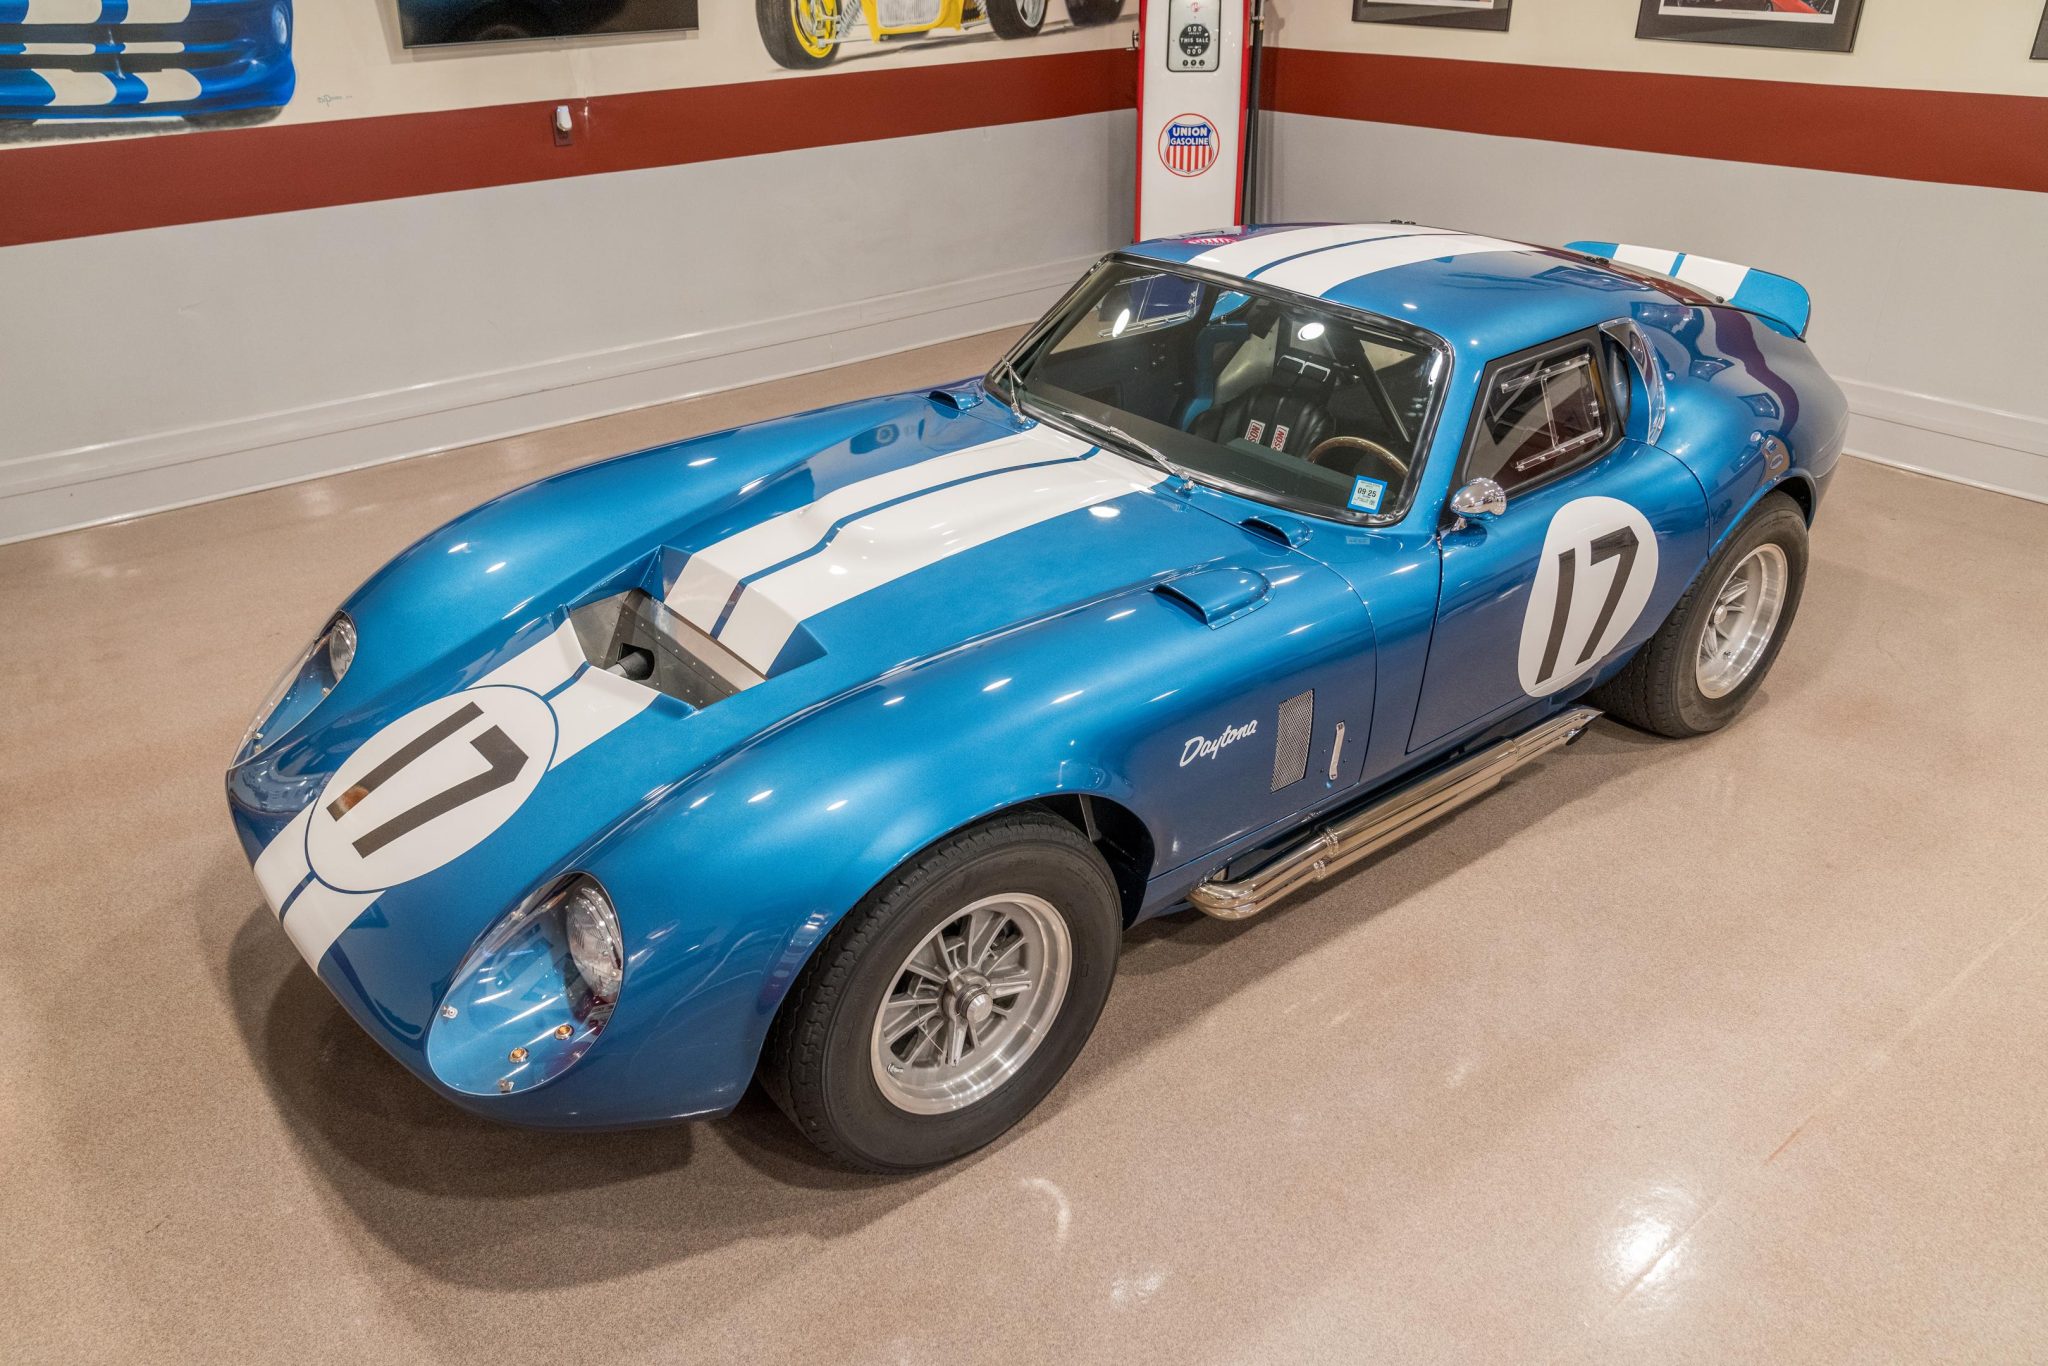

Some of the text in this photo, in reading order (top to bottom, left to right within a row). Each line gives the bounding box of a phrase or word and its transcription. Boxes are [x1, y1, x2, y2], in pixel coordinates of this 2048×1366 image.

[1170, 137, 1209, 145] GASOLINE
[1172, 127, 1208, 137] UNION
[1357, 487, 1367, 495] 09
[1367, 489, 1377, 498] 25
[1535, 525, 1640, 686] 17
[1179, 719, 1258, 768] Daytona
[326, 701, 530, 859] 17
